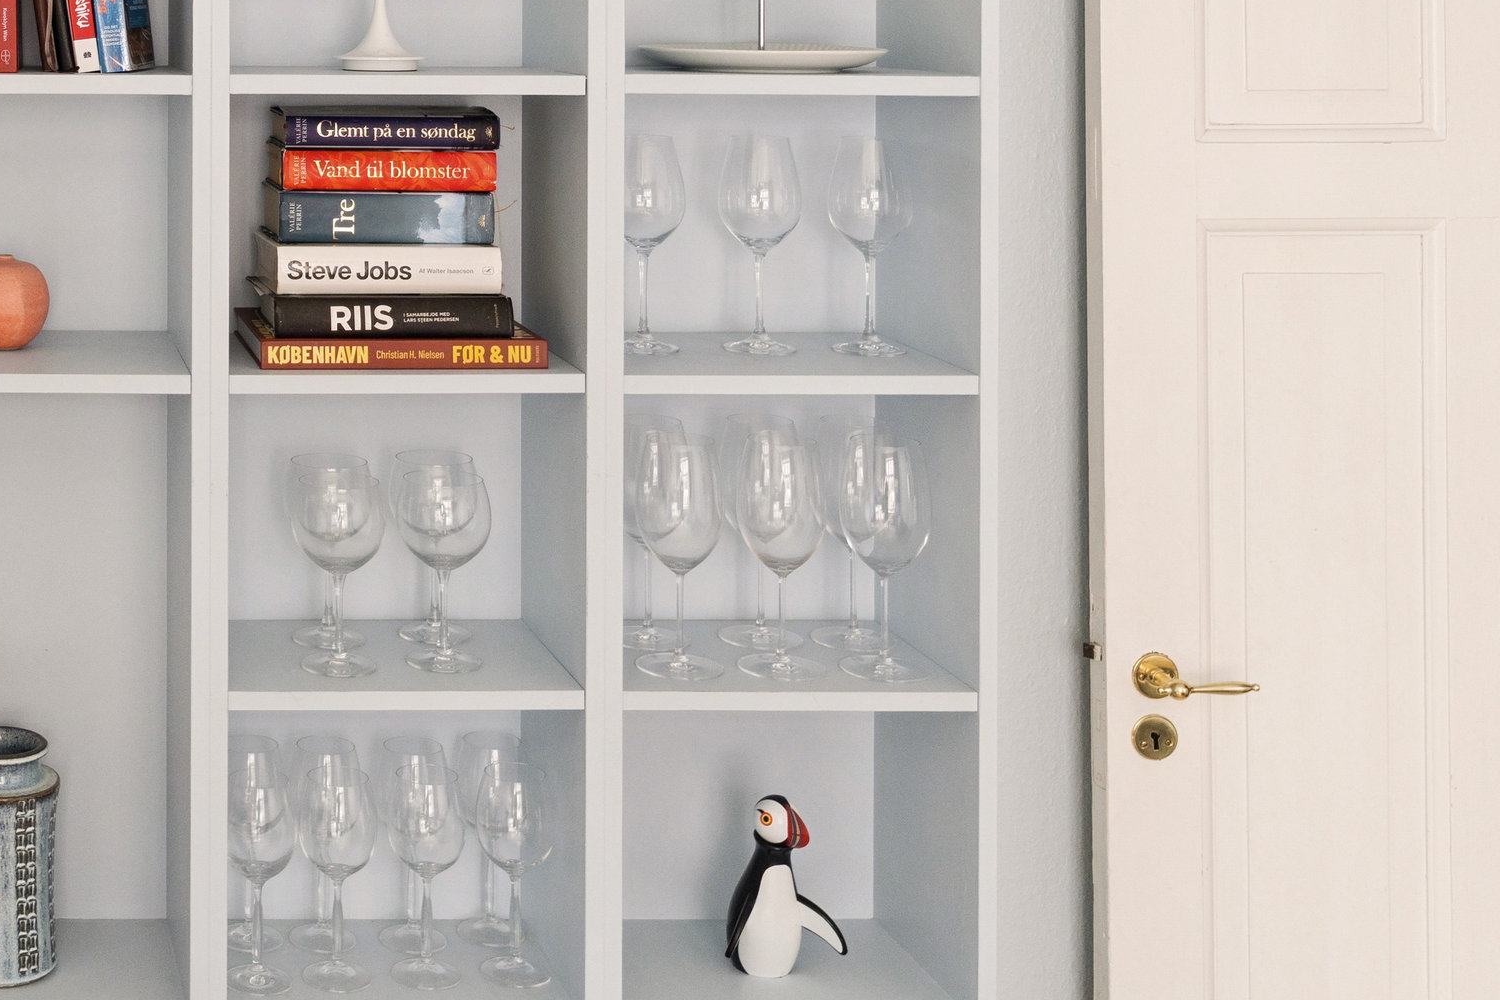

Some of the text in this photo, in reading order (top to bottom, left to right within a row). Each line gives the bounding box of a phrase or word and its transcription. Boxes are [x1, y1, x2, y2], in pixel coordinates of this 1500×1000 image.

[316, 119, 477, 142] Glemt på en søndag
[314, 159, 471, 180] Vand til blomster
[332, 197, 356, 241] Tre
[287, 259, 412, 281] Steve Jobs
[329, 305, 394, 332] RIIS
[267, 344, 369, 365] KØBENHAVN
[376, 349, 445, 360] Christian H. Nielsen
[452, 344, 486, 364] FØR
[490, 345, 504, 363] &
[508, 345, 532, 364] NU
